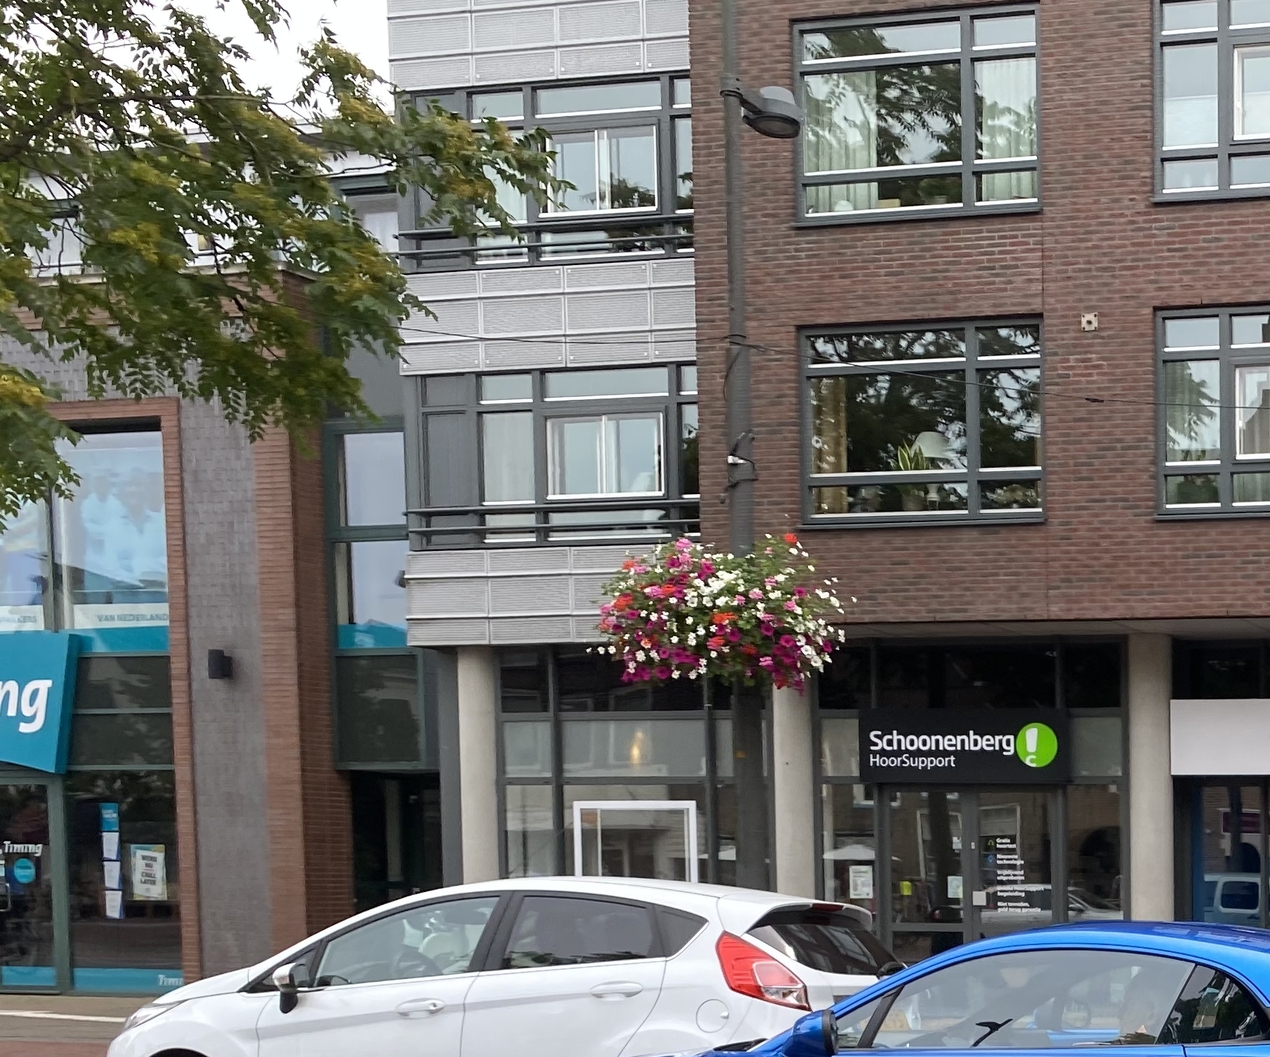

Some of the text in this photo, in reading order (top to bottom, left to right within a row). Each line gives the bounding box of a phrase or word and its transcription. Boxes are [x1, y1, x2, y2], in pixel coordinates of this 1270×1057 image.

[869, 730, 1015, 756] Schoonenberg
[869, 754, 956, 770] HoorSupport
[3, 841, 43, 856] Timing
